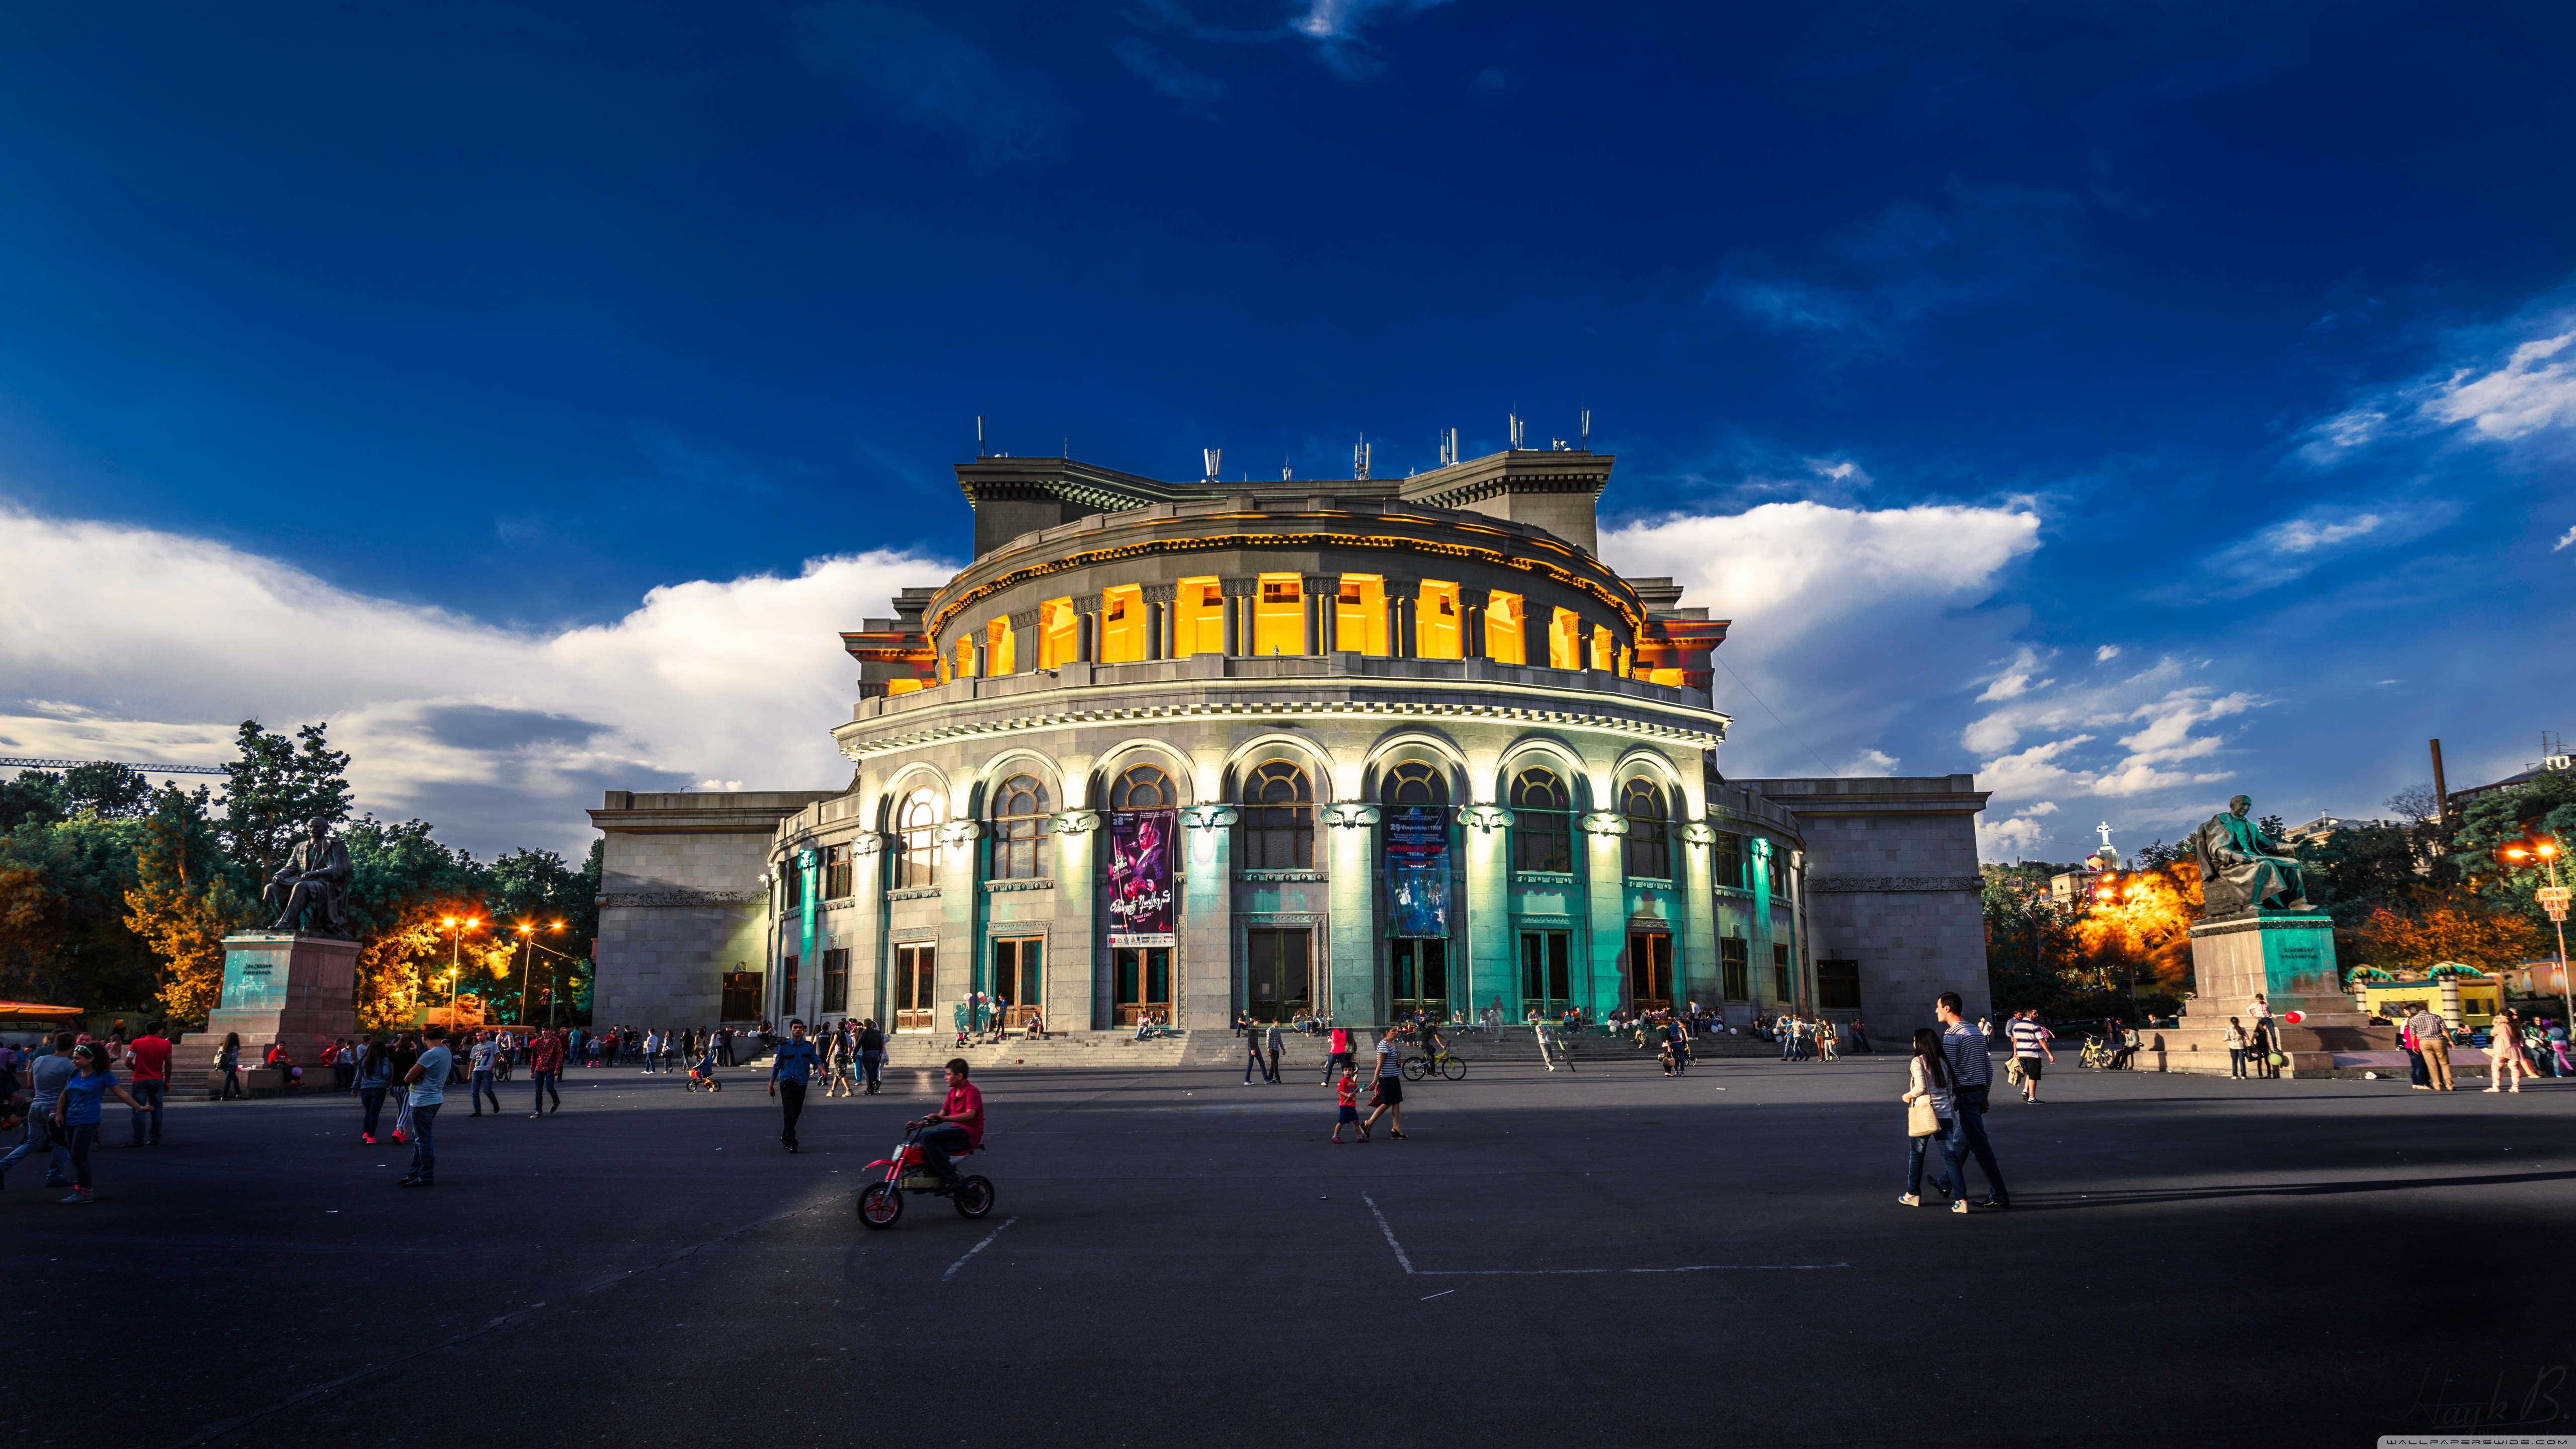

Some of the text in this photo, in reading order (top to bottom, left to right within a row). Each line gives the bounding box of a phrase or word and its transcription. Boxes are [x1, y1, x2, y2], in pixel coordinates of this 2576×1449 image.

[1112, 817, 1123, 826] 28
[1390, 824, 1401, 832] 29
[483, 1053, 491, 1066] 7
